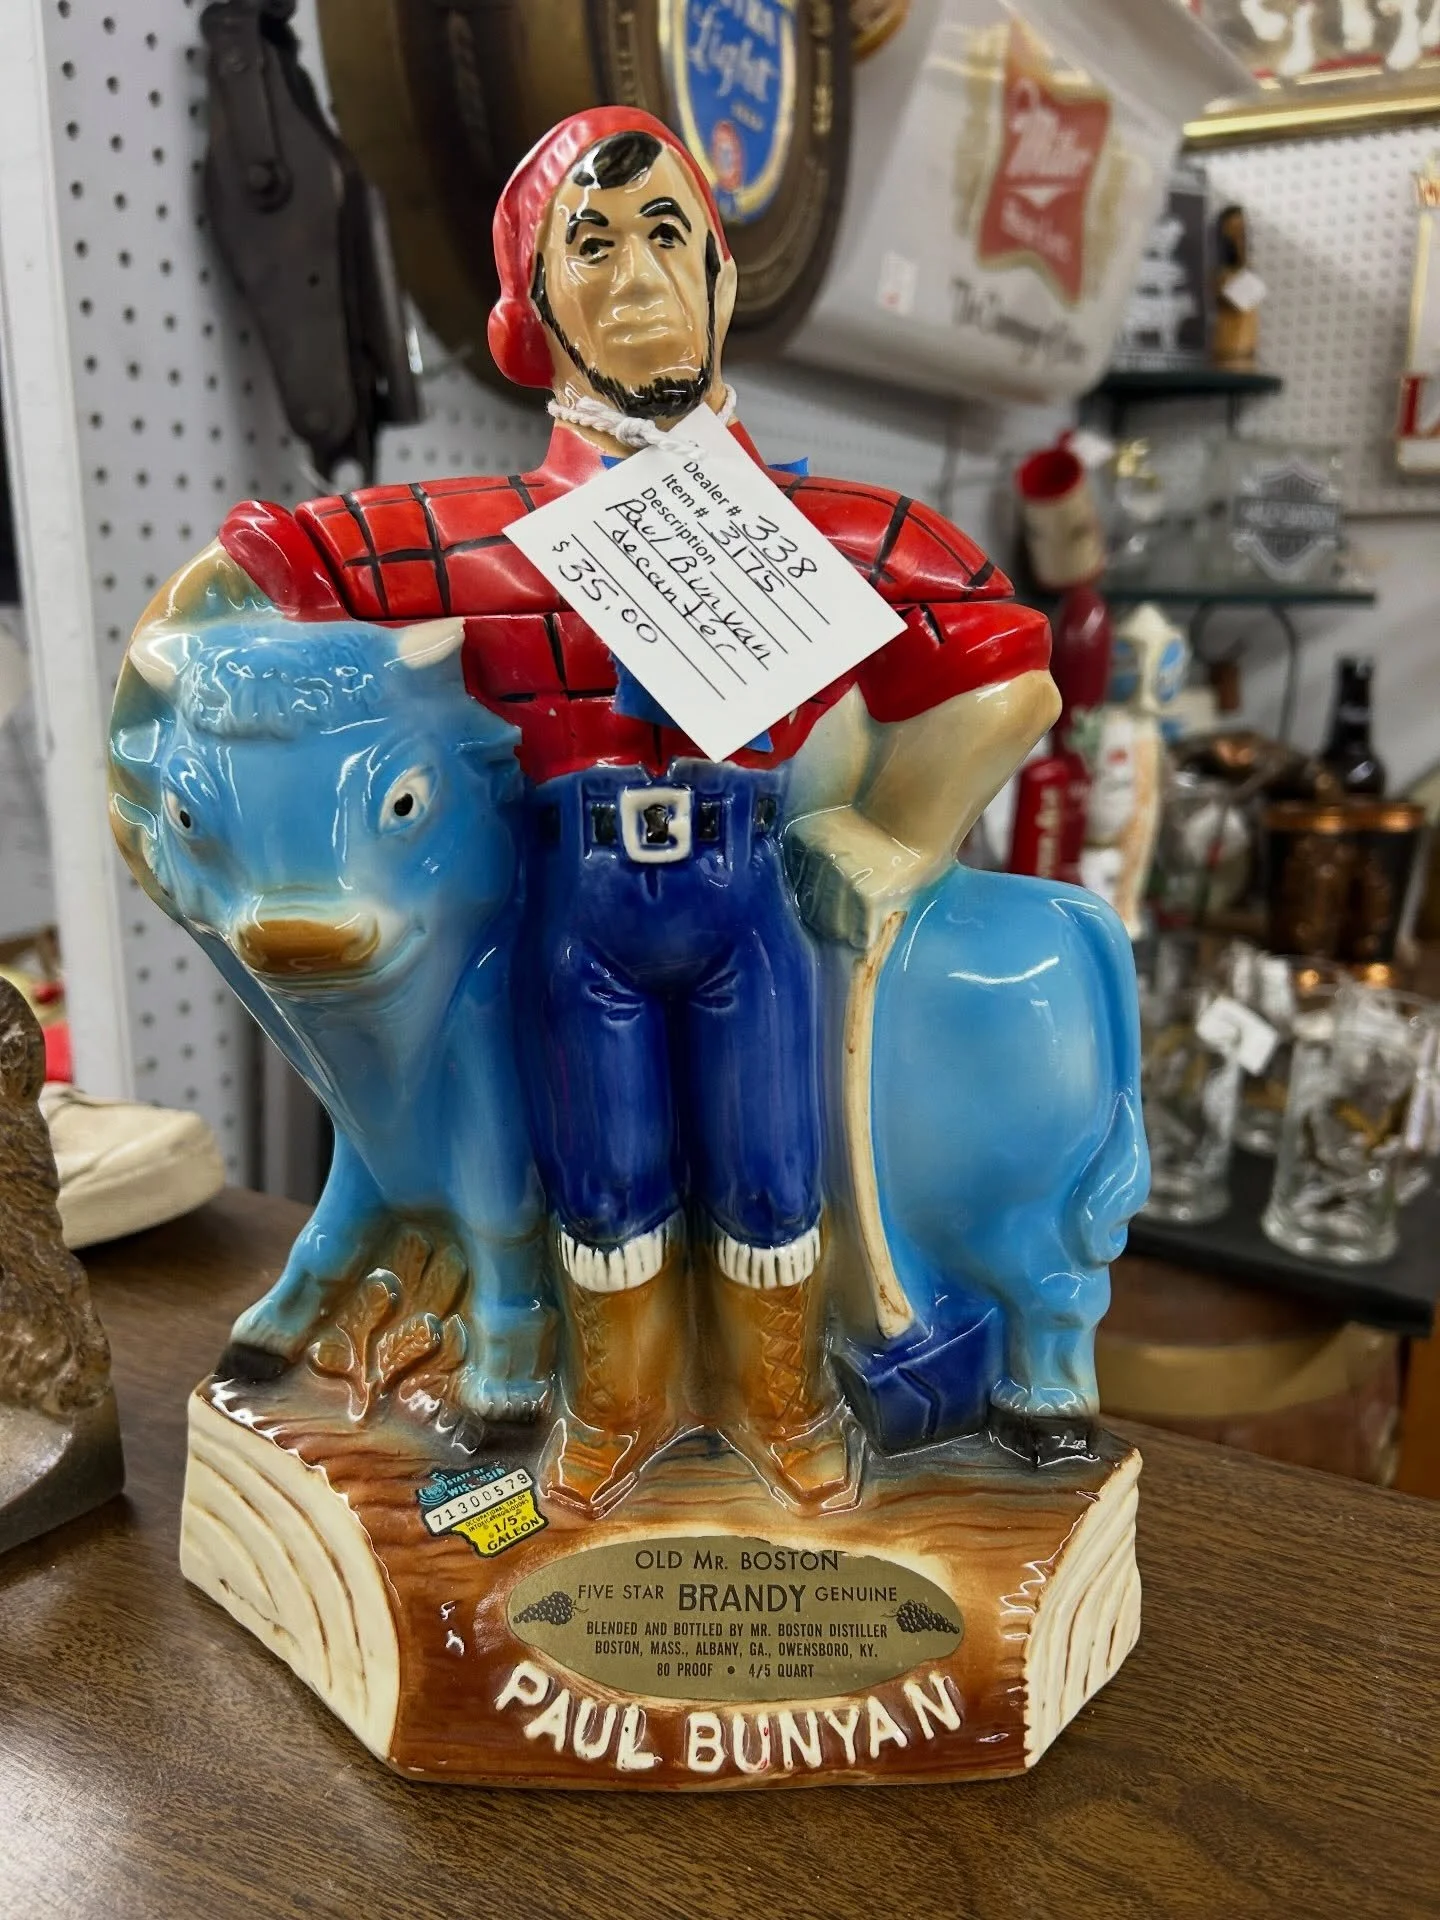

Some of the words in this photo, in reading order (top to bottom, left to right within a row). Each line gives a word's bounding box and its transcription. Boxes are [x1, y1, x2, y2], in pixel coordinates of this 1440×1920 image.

[640, 487, 716, 566] Description
[661, 473, 696, 508] Item
[693, 507, 710, 518] #
[709, 525, 786, 592] 3175
[683, 461, 730, 505] Dealer
[726, 505, 742, 517] #
[742, 515, 818, 578] 338
[552, 540, 570, 553] $
[605, 499, 674, 543] Paul
[667, 555, 771, 660] Bunyan
[558, 558, 658, 645] 35.00
[446, 1471, 472, 1485] STATE
[473, 1467, 484, 1476] OF
[432, 1473, 528, 1526] 71300579
[487, 1516, 540, 1551] GALLON
[493, 1515, 518, 1534] 1/5
[635, 1549, 683, 1570] OLD
[741, 1550, 839, 1571] BOSTON
[577, 1584, 614, 1600] FIVE
[623, 1584, 665, 1600] STAR
[678, 1583, 807, 1612] BRANDY
[814, 1586, 898, 1602] GENUINE
[586, 1621, 638, 1636] BLENDED
[644, 1622, 667, 1636] AND
[673, 1622, 723, 1637] BOTTLED
[729, 1623, 744, 1637] BY
[750, 1623, 771, 1637] MR.
[778, 1623, 822, 1638] BOSTON
[829, 1623, 888, 1639] DISTILLER
[595, 1640, 643, 1656] BOSTON,
[650, 1640, 689, 1657] MASS.,
[695, 1641, 743, 1658] ALBANY,
[749, 1642, 771, 1658] GA.,
[778, 1642, 852, 1659] OWENSBORO,
[859, 1643, 878, 1658] KY.
[656, 1662, 670, 1677] 80
[677, 1662, 714, 1677] PROOF
[748, 1663, 771, 1679] 4/5
[777, 1664, 815, 1678] QUART
[494, 1660, 661, 1772] PAUL
[686, 1673, 962, 1773] BUNYAN
